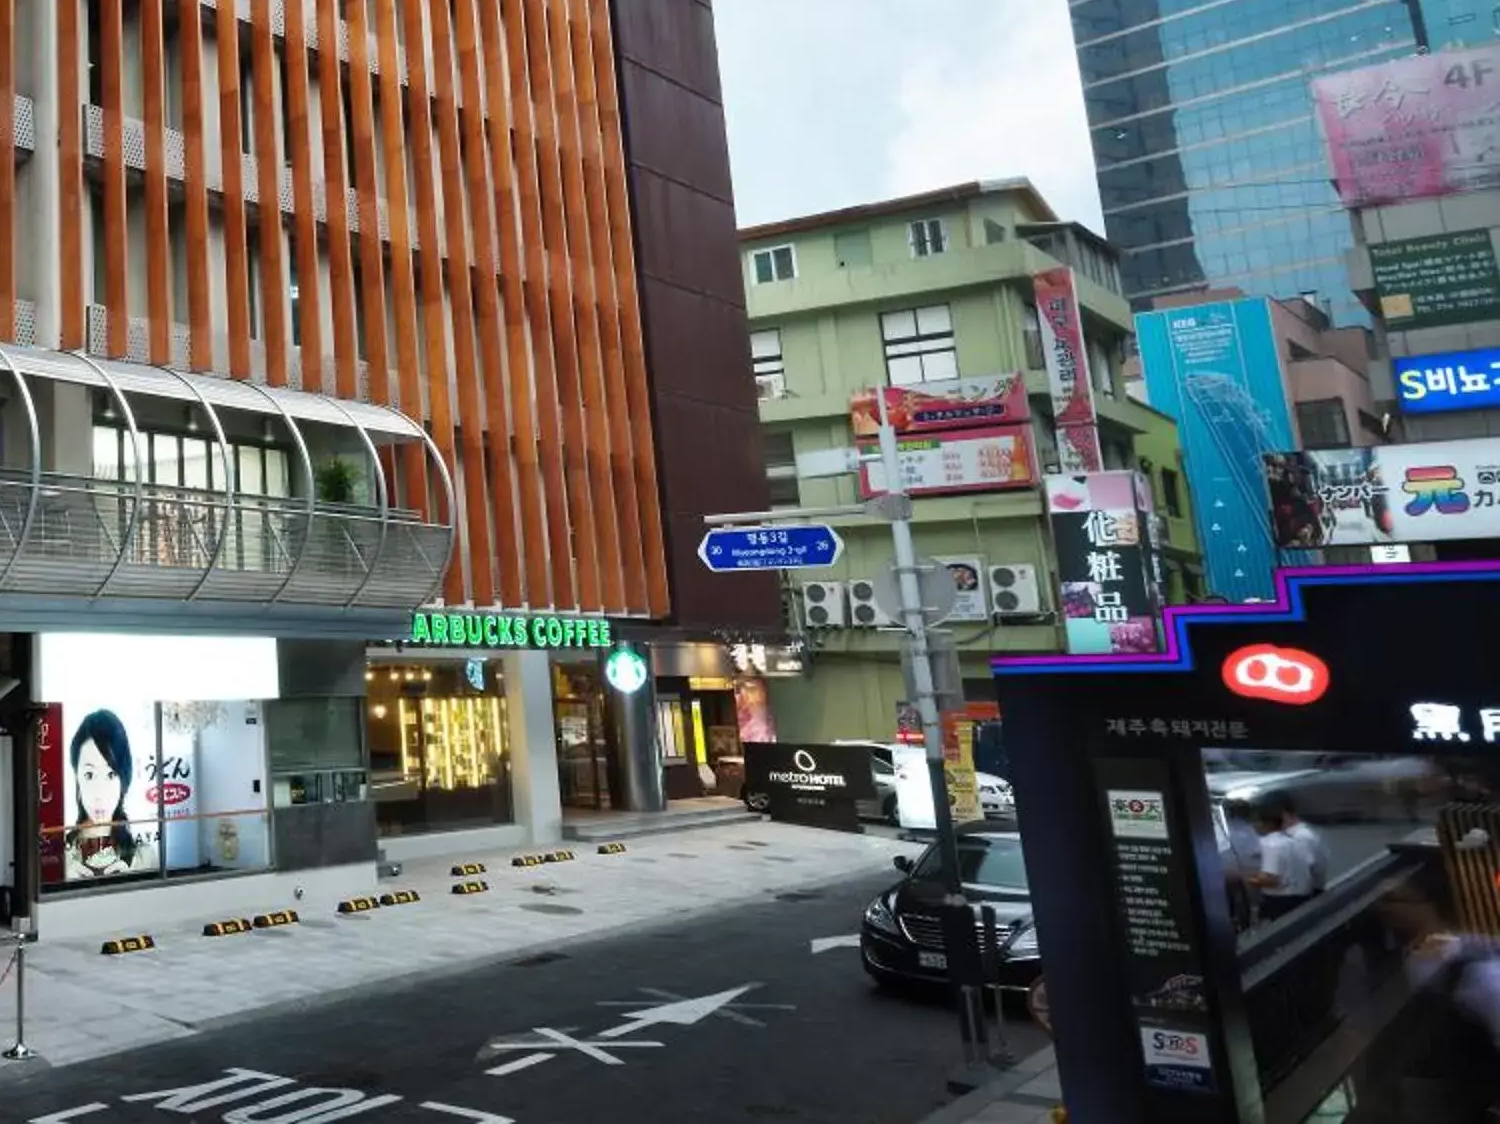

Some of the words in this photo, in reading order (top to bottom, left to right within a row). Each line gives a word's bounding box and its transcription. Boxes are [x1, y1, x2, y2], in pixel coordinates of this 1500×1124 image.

[1443, 59, 1493, 89] 4F
[1400, 360, 1500, 400] S비뇨
[1402, 465, 1470, 516] 元
[1082, 510, 1128, 622] 化粧品
[531, 616, 611, 647] COFFEE
